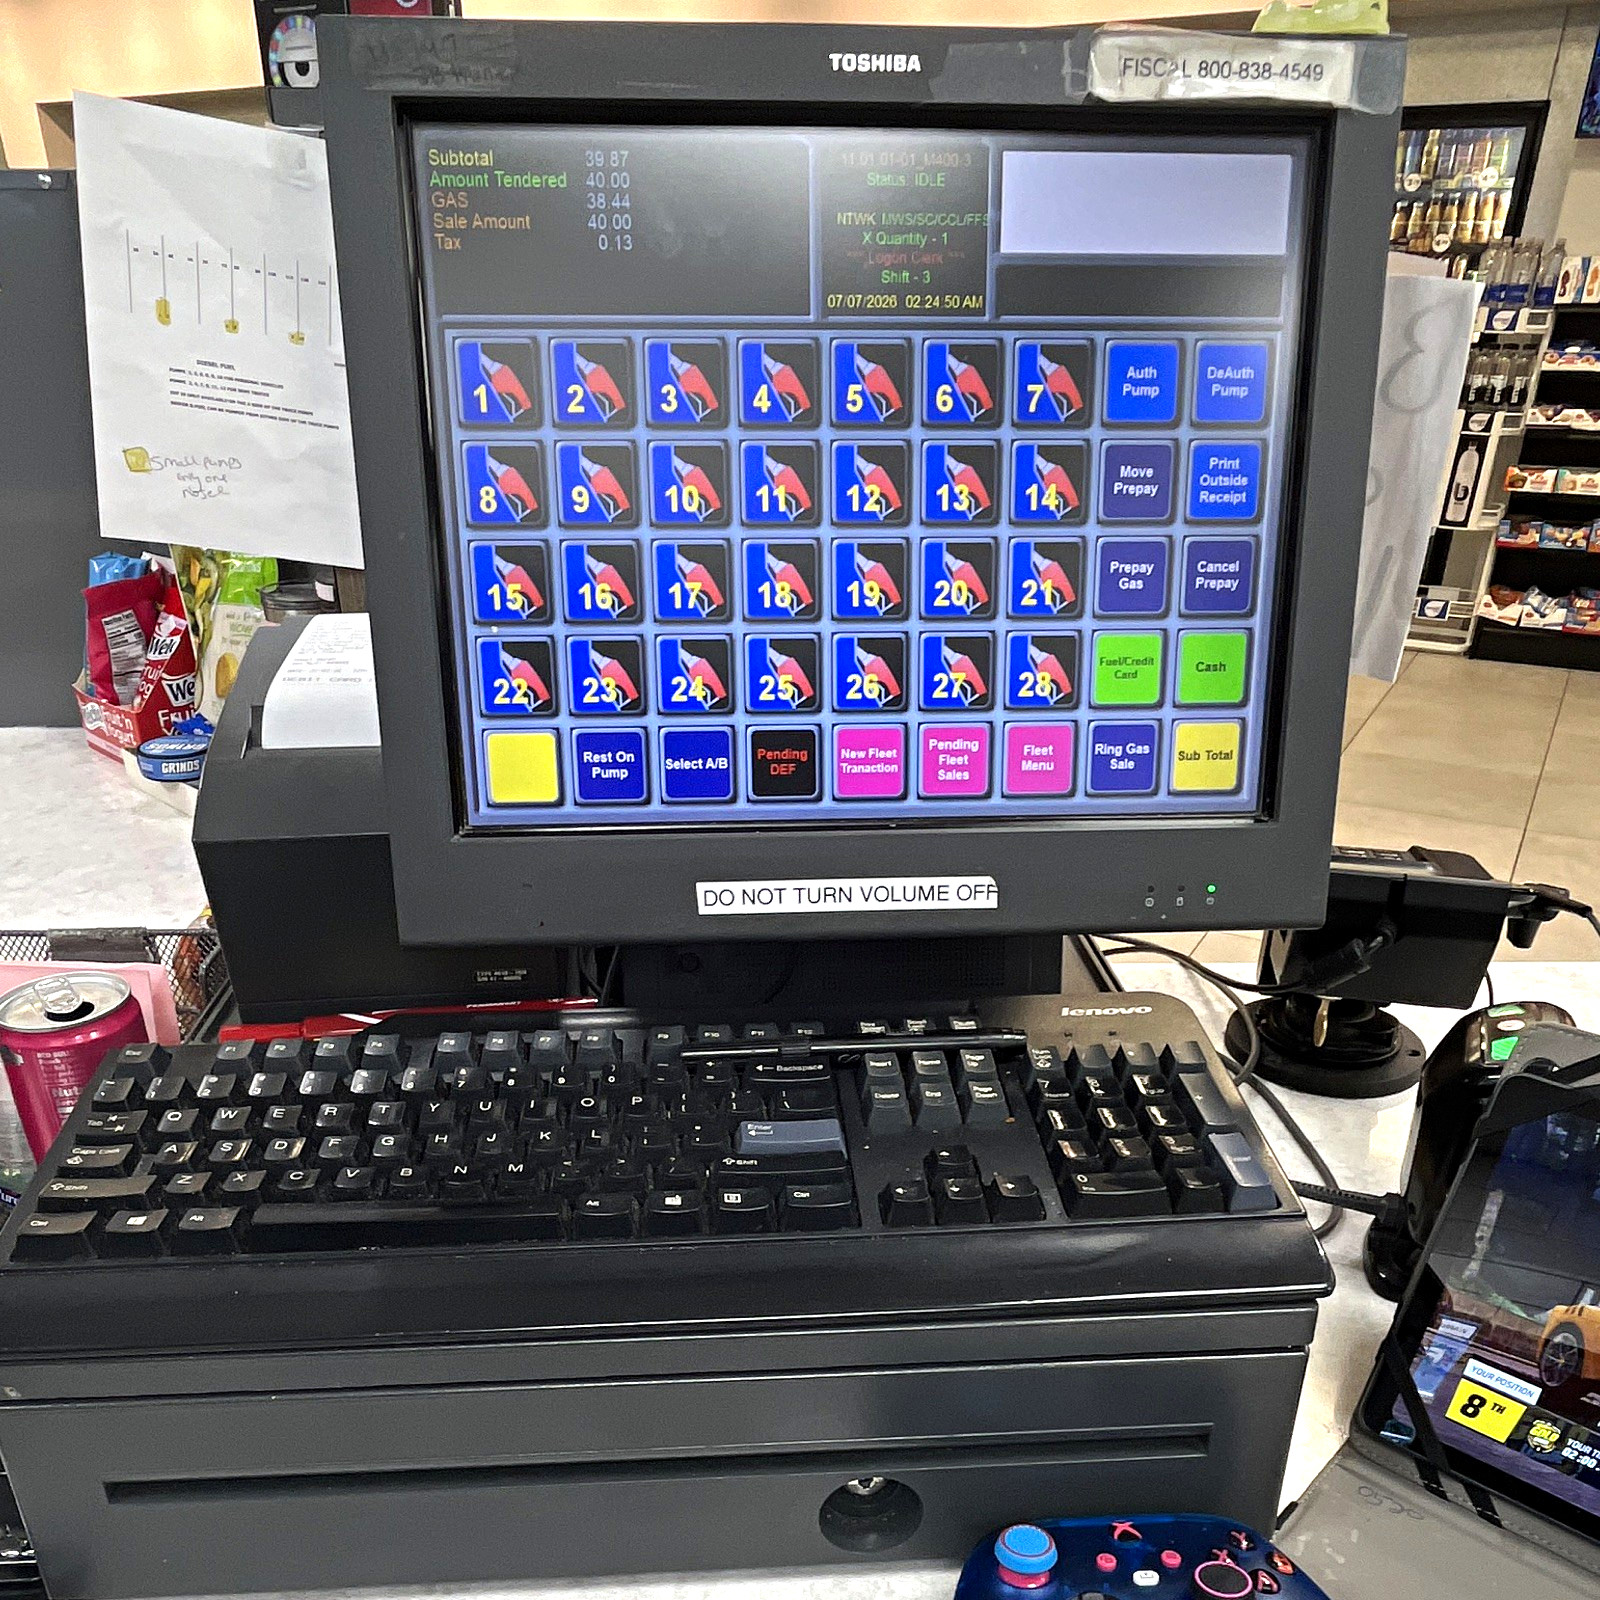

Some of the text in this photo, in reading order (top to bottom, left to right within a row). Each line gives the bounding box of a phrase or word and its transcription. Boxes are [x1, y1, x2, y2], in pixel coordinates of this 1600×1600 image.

[829, 53, 922, 73] TOSHIBA
[1198, 60, 1324, 82] 800-838-4549
[428, 149, 494, 166] Subtotal
[429, 171, 489, 187] Amount
[494, 171, 568, 188] Tendered
[915, 172, 946, 187] IDLE
[431, 191, 631, 209] GAS 38.44
[433, 213, 468, 229] Sale
[472, 213, 531, 229] Amount
[837, 212, 877, 226] NTWK
[434, 233, 633, 250] Tax 0.13
[862, 232, 872, 245] X
[876, 231, 928, 248] Quantity
[941, 232, 948, 245] 1
[881, 269, 910, 284] Shift
[923, 270, 931, 284] 3
[827, 294, 898, 309] 07/07/2026
[962, 294, 983, 309] AM
[1126, 366, 1157, 379] Auth
[1207, 366, 1254, 379] DeAuth
[473, 384, 488, 413] 1
[566, 384, 585, 413] 2
[661, 384, 678, 413] 3
[753, 384, 771, 413] 4
[846, 384, 863, 413] 5
[935, 384, 953, 413] 6
[1026, 384, 1044, 413] 7
[1122, 383, 1160, 399] Pump
[1211, 383, 1249, 399] Pump
[1209, 457, 1240, 470] Print
[1120, 465, 1154, 479] Move
[1199, 474, 1249, 486] Outside
[1025, 483, 1059, 511] 14
[1113, 482, 1159, 498] Prepay
[479, 486, 498, 514] 8
[571, 486, 590, 513] 9
[665, 485, 701, 513] 10
[756, 485, 786, 513] 11
[847, 484, 881, 512] 12
[936, 484, 970, 512] 13
[1199, 490, 1247, 506] Receipt
[1110, 560, 1155, 576] Prepay
[1197, 560, 1240, 573] Cancel
[1118, 577, 1144, 590] Gas
[1195, 577, 1240, 592] Prepay
[487, 582, 523, 611] 15
[579, 582, 615, 610] 16
[668, 582, 702, 609] 17
[758, 581, 791, 609] 18
[847, 580, 881, 608] 19
[933, 580, 968, 607] 20
[1020, 579, 1053, 606] 21
[1100, 656, 1155, 667] Fuel/Credit
[1195, 661, 1227, 673] Cash
[1114, 669, 1138, 680] Card
[494, 678, 529, 705] 22
[582, 677, 618, 704] 23
[671, 676, 706, 702] 24
[758, 674, 794, 701] 25
[846, 673, 880, 700] 26
[932, 672, 966, 699] 27
[1018, 671, 1052, 698] 28
[928, 738, 980, 752] Pending
[1023, 744, 1054, 756] Fleet
[1095, 743, 1150, 758] Ring Gas
[583, 751, 635, 763] Rest On
[757, 748, 809, 763] Pending
[841, 747, 897, 760] New Fleet
[938, 754, 969, 766] Fleet
[1177, 749, 1233, 762] Sub Total
[665, 757, 728, 770] Select A/B
[770, 763, 797, 775] DEF
[840, 761, 899, 774] Tranaction
[1021, 759, 1054, 771] Menu
[1109, 758, 1135, 770] Sale
[591, 766, 629, 781] Pump
[937, 768, 970, 781] Sales
[704, 884, 999, 907] DO NOT TURN VOLUME OFF
[1061, 1004, 1153, 1018] lenovo
[429, 1103, 440, 1112] Y
[479, 1101, 492, 1111] U
[529, 1100, 535, 1109] I
[580, 1097, 595, 1107] O
[631, 1097, 643, 1106] P
[167, 1111, 182, 1121] Q
[221, 1110, 238, 1120] W
[272, 1108, 286, 1118] E
[324, 1106, 338, 1116] R
[378, 1105, 390, 1114] T
[381, 1136, 395, 1147] G
[434, 1134, 448, 1143] H
[486, 1133, 497, 1142] J
[539, 1131, 551, 1140] K
[591, 1129, 601, 1139] L
[163, 1144, 178, 1153] A
[219, 1142, 234, 1151] S
[273, 1140, 288, 1150] D
[327, 1137, 343, 1148] F
[345, 1169, 360, 1178] V
[399, 1168, 414, 1177] B
[454, 1165, 468, 1174] N
[508, 1163, 524, 1172] M
[177, 1175, 193, 1184] Z
[232, 1173, 248, 1182] X
[289, 1171, 304, 1181] C
[1472, 1365, 1535, 1398] YOUR POSITION
[1460, 1393, 1507, 1419] 8 TH
[1566, 1437, 1593, 1455] YOUR
[1257, 1570, 1279, 1592] A
